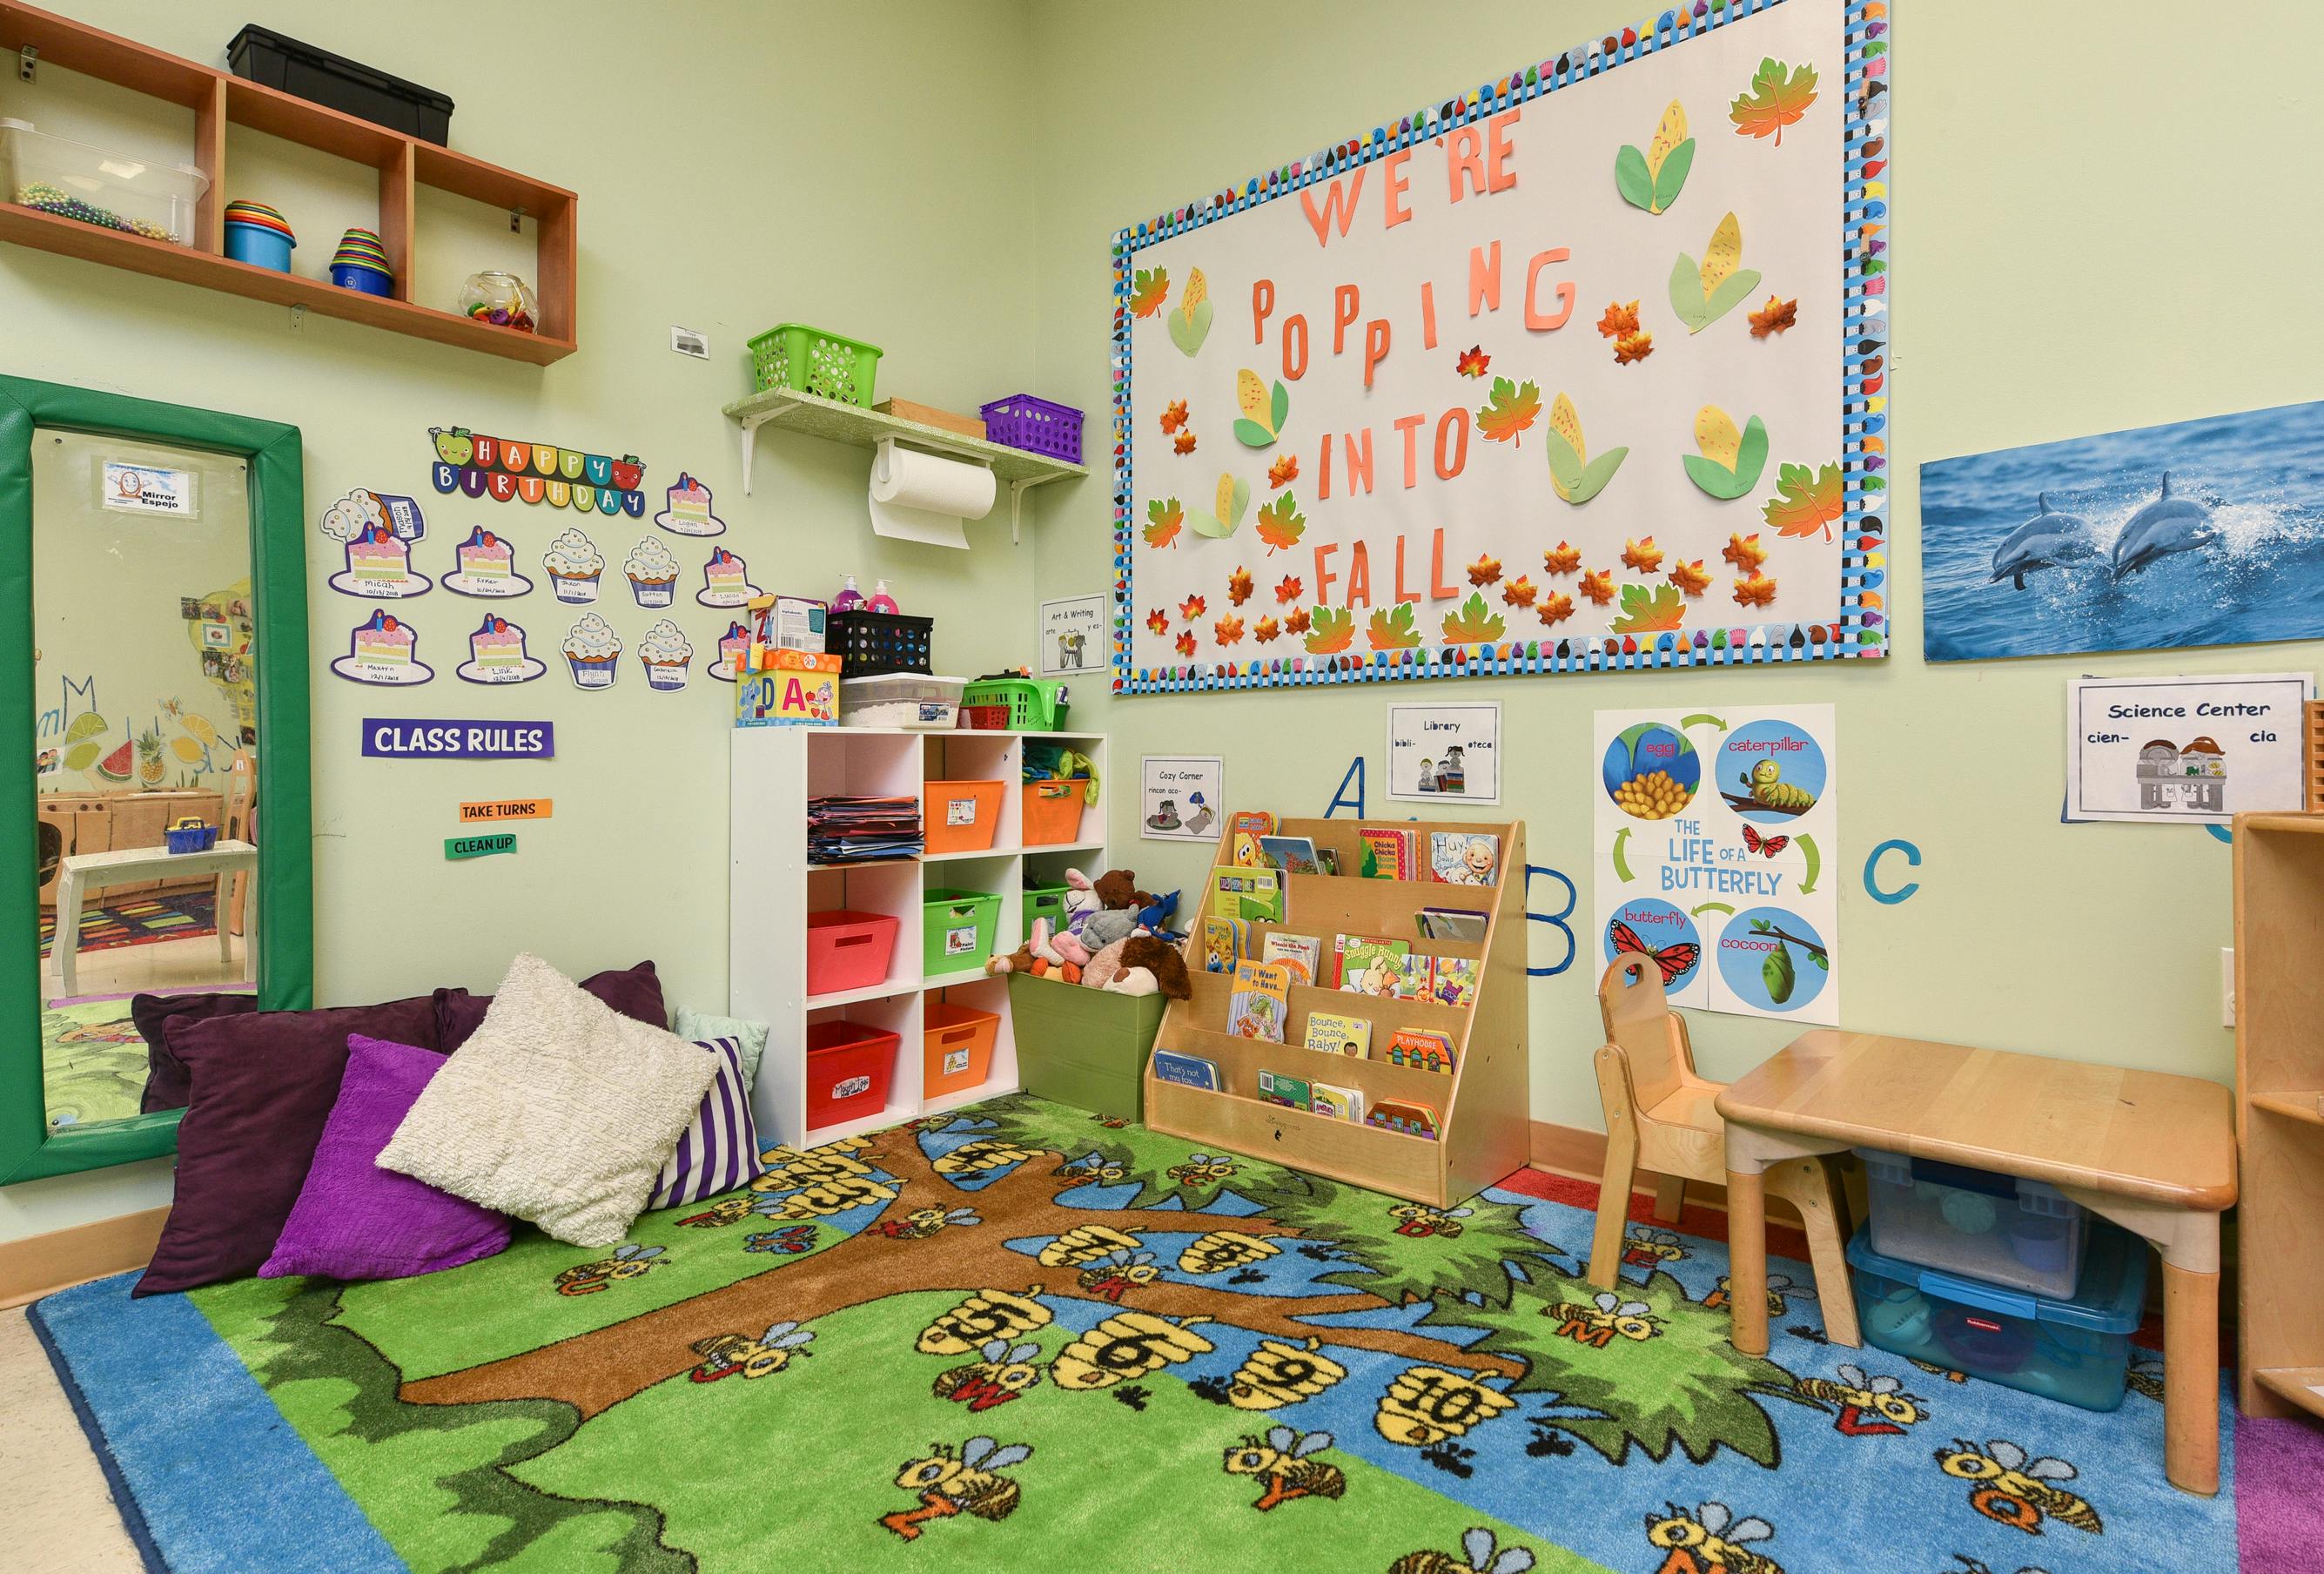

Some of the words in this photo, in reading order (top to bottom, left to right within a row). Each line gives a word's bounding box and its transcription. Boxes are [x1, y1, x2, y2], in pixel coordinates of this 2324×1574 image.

[1300, 108, 1521, 247] WE'RE
[1253, 240, 1575, 387] POPPING
[479, 441, 606, 478] HAPPY
[1318, 407, 1469, 500] INTO
[142, 491, 177, 501] Mirror
[439, 466, 639, 511] BIRTHDAY
[142, 498, 178, 508] Espejo
[1314, 528, 1459, 609] FALL
[1063, 611, 1069, 620] &
[1070, 609, 1094, 618] Writing
[762, 677, 775, 710] D
[783, 678, 806, 711] A
[2108, 703, 2186, 719] Science
[2196, 702, 2271, 717] Center
[1423, 721, 1461, 733] Library
[2087, 730, 2131, 744] cien-
[2249, 730, 2277, 743] cia
[374, 726, 461, 752] CLASS
[467, 728, 543, 752] RULES
[1394, 739, 1417, 748] bibli-
[1645, 743, 1675, 757] egg
[1728, 737, 1810, 757] caterpillar
[1159, 771, 1176, 782] Cozy
[1179, 771, 1204, 781] Corner
[1323, 756, 1365, 820] A
[462, 805, 494, 818] TAKE
[496, 803, 536, 817] TURNS
[1674, 818, 1700, 836] THE
[454, 838, 494, 854] CLEAN
[496, 837, 514, 851] UP
[1669, 838, 1714, 864] LIFE
[1719, 848, 1736, 862] OF
[1736, 848, 1746, 862] A
[1661, 865, 1783, 897] BUTTERFLY
[1864, 839, 1922, 905] C
[1625, 907, 1686, 930] butterfly
[1344, 944, 1376, 960] Snuggle
[1721, 938, 1778, 952] cocoon
[1258, 969, 1278, 980] Want
[1309, 1016, 1346, 1029] Bounce,
[1312, 1027, 1349, 1040] Bounce,
[1307, 1039, 1341, 1053] Baby!
[1396, 1035, 1437, 1050] PLAYHOUSE
[1164, 1062, 1186, 1074] That's
[1186, 1069, 1199, 1078] not
[810, 1186, 871, 1209] 3
[1203, 1241, 1251, 1263] 8
[1088, 1276, 1141, 1302] K
[946, 1302, 1031, 1339] 5
[1558, 1318, 1615, 1349] M
[1096, 1333, 1168, 1369] 6
[1257, 1358, 1316, 1387] 9
[1399, 1374, 1480, 1422] 10
